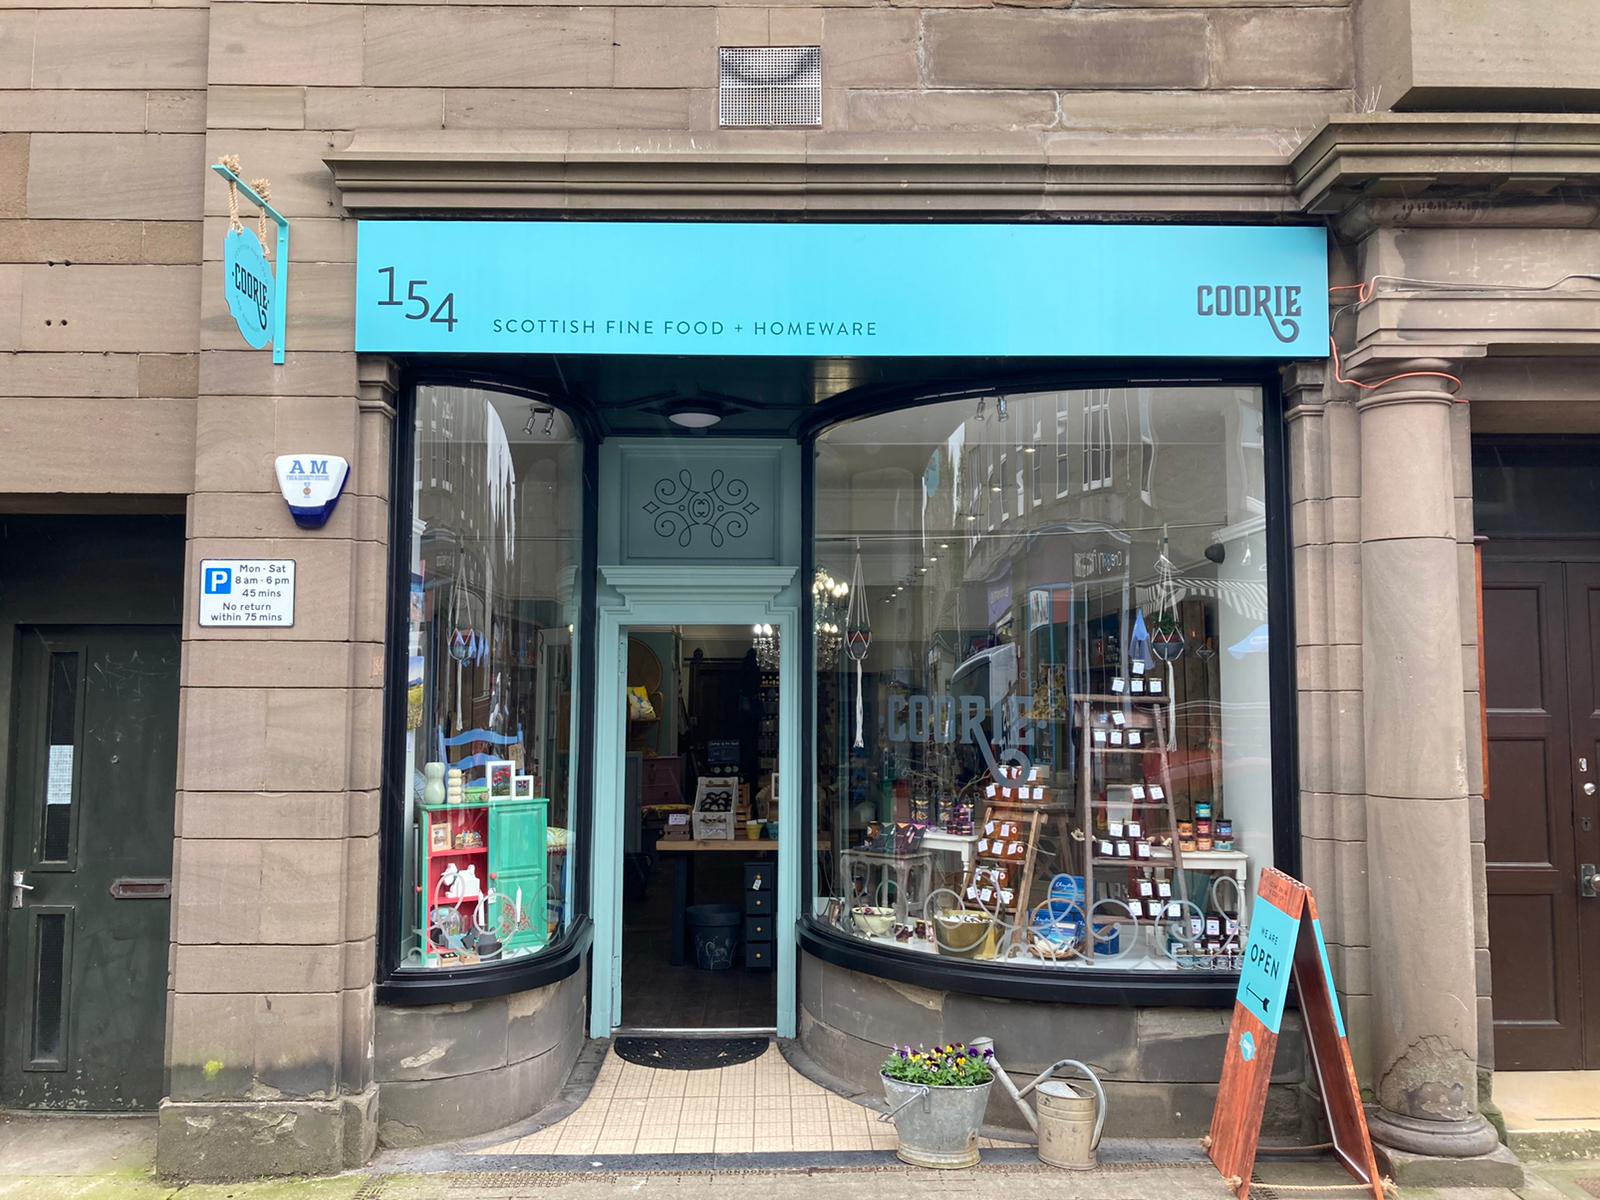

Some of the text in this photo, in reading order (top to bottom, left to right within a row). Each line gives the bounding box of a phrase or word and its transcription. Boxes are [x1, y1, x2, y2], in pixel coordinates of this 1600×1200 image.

[234, 262, 269, 331] COORIE
[377, 265, 459, 333] 154
[1197, 285, 1302, 344] COORIE
[493, 319, 595, 334] SCOTTISH
[606, 320, 653, 334] FINE
[664, 321, 724, 335] FOOD
[754, 321, 877, 336] HOMEWARE
[240, 564, 261, 573] Mon
[269, 564, 286, 573] Sat
[211, 570, 228, 592] P
[242, 588, 282, 597] 45 mins
[211, 612, 283, 621] within 75 mins
[222, 602, 271, 611] No return
[887, 695, 1035, 788] COORIE
[1250, 943, 1280, 980] OPEN
